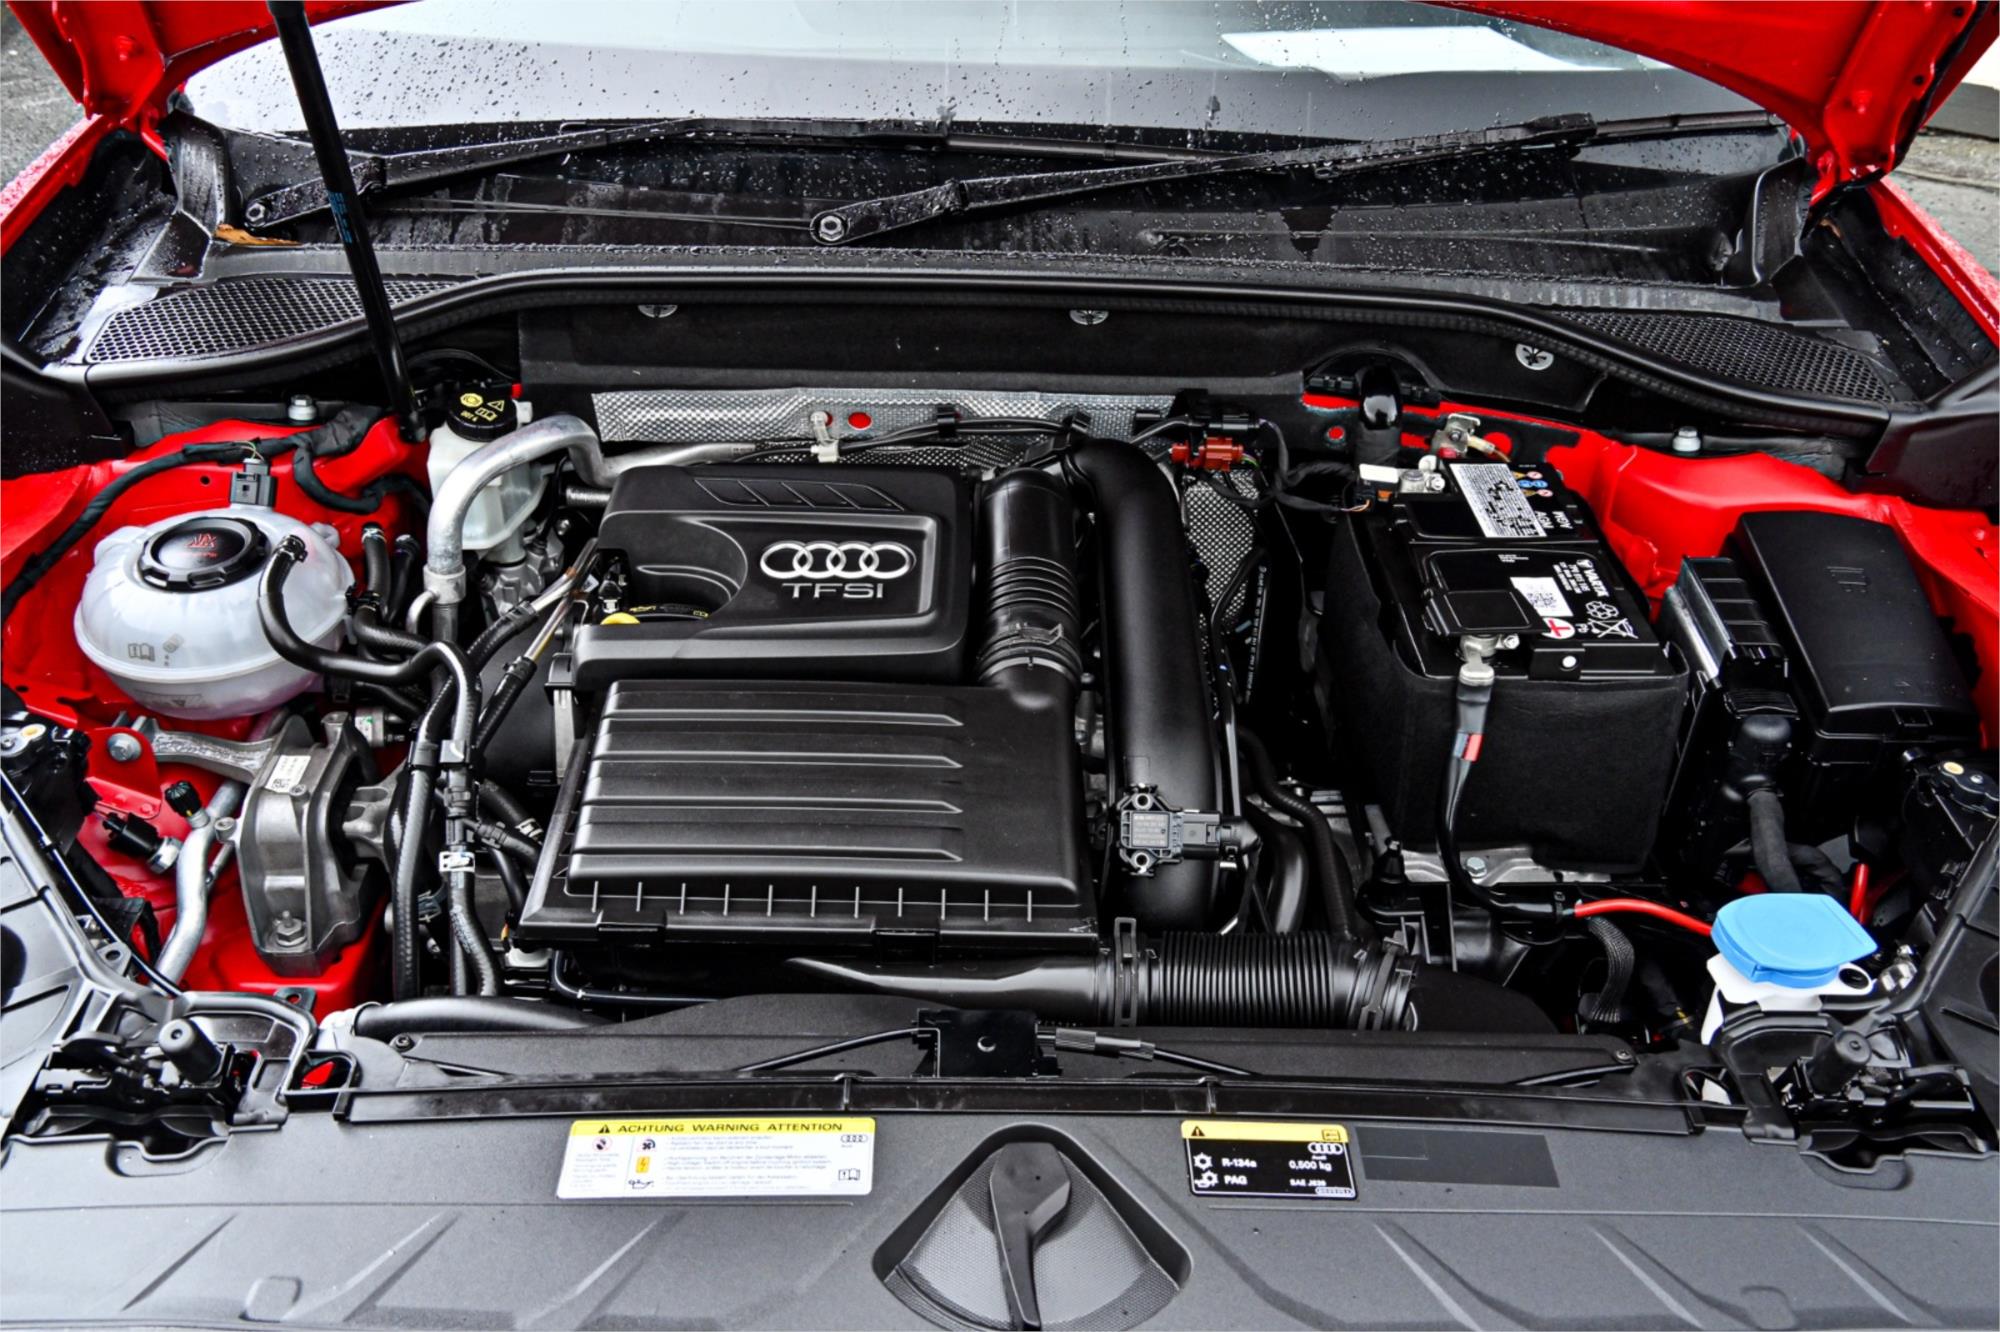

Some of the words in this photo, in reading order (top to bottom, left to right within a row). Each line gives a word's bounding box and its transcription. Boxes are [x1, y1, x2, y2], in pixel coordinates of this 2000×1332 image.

[1584, 569, 1609, 597] VARTA
[782, 583, 883, 598] TFSI
[618, 1125, 684, 1133] ACHTUNG
[692, 1124, 759, 1132] WARNING
[767, 1123, 843, 1131] ATTENTION
[1221, 1158, 1257, 1168] R-134a
[1288, 1160, 1317, 1170] 0,500
[1319, 1161, 1332, 1172] kg
[1223, 1175, 1248, 1185] PAG
[1289, 1178, 1306, 1186] SAE
